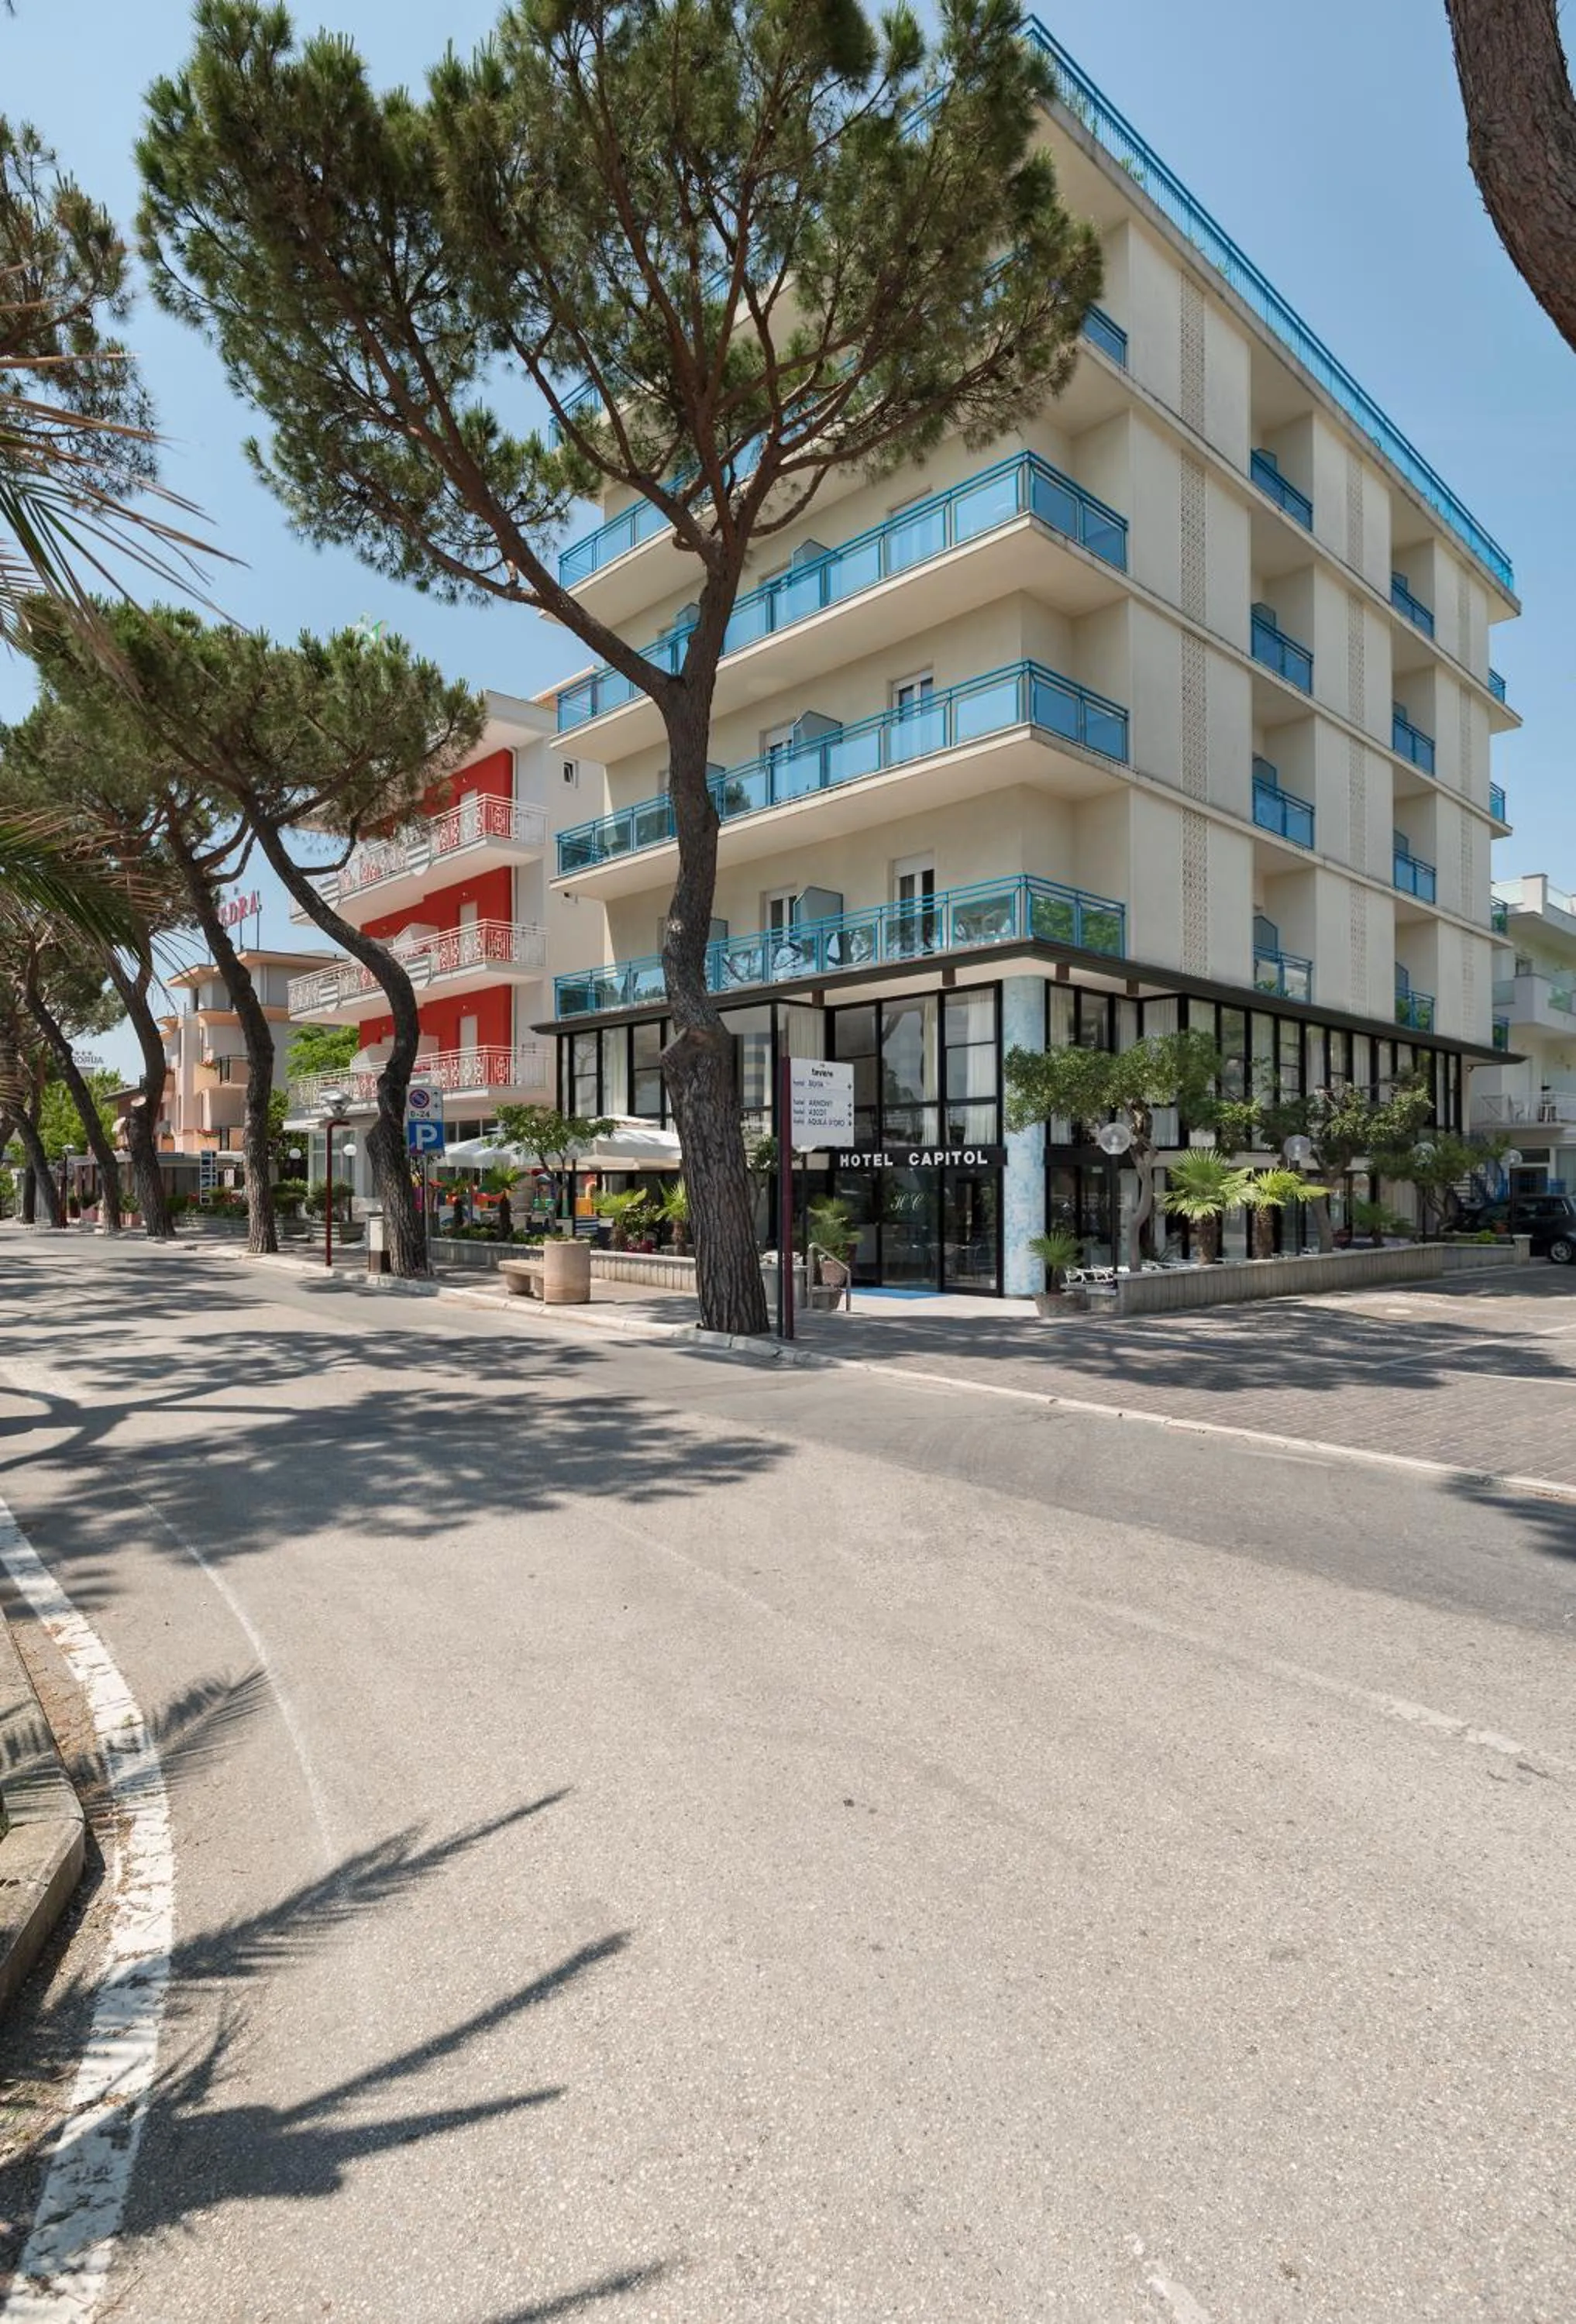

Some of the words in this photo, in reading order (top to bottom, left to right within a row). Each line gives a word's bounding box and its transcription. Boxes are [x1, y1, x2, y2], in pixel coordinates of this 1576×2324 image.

[415, 1124, 438, 1150] P
[839, 1153, 893, 1167] HOTEL
[908, 1150, 988, 1166] CAPITOL
